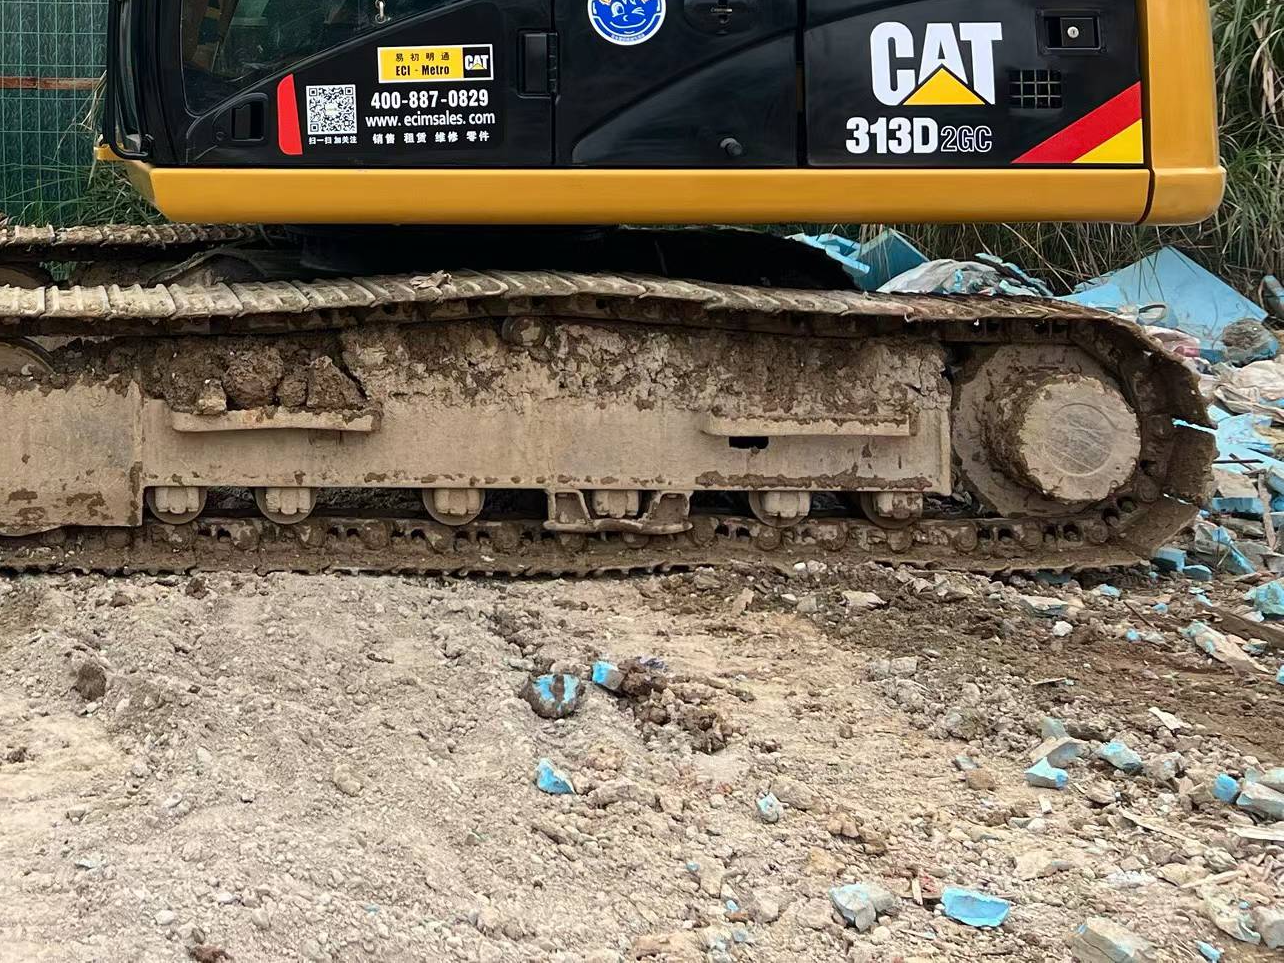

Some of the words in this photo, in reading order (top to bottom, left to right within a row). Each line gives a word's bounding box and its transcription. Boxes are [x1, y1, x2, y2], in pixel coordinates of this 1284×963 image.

[395, 51, 450, 62] 易初明通
[464, 54, 489, 71] CAT
[869, 21, 1003, 106] CAT
[395, 65, 411, 76] ECI
[421, 64, 450, 76] Metro
[370, 89, 489, 110] 400-887-0829
[372, 132, 396, 145] 销售
[403, 131, 427, 144] 租赁
[434, 130, 459, 143] 维修
[466, 130, 490, 142] 零件
